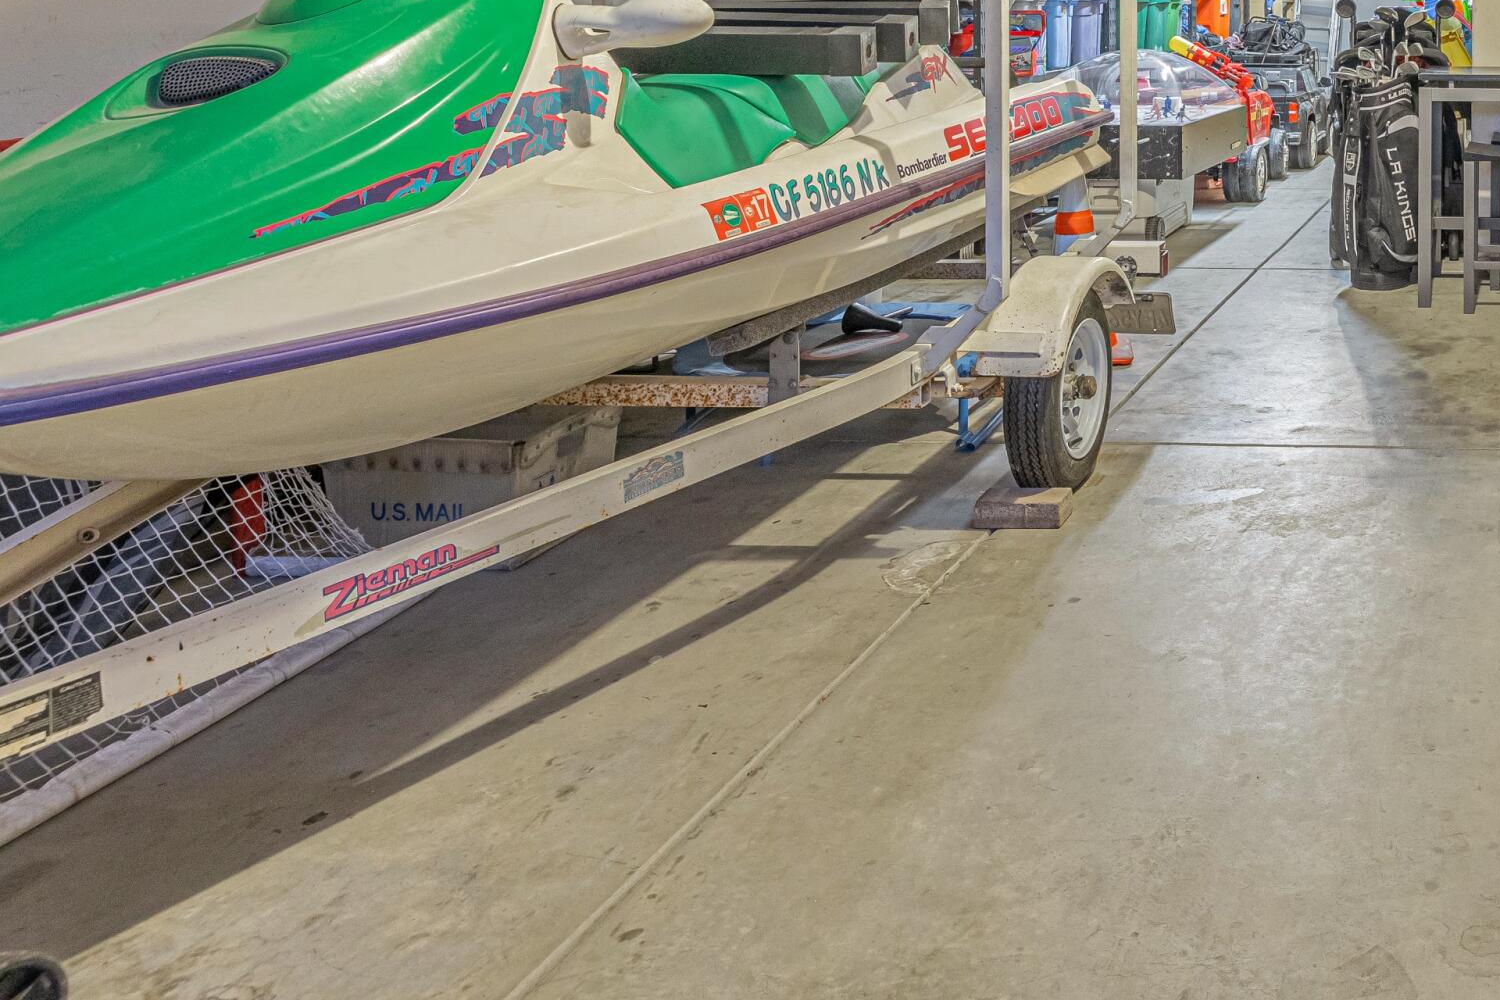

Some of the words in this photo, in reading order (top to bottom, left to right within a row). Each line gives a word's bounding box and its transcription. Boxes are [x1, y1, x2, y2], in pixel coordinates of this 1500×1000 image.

[897, 153, 947, 178] Bombardier
[1387, 147, 1402, 175] LA
[752, 193, 769, 220] 17
[769, 179, 802, 222] CF
[804, 164, 855, 212] 5186
[1394, 181, 1416, 241] KINGS
[370, 503, 410, 522] U.S.
[323, 543, 457, 622] Zieman
